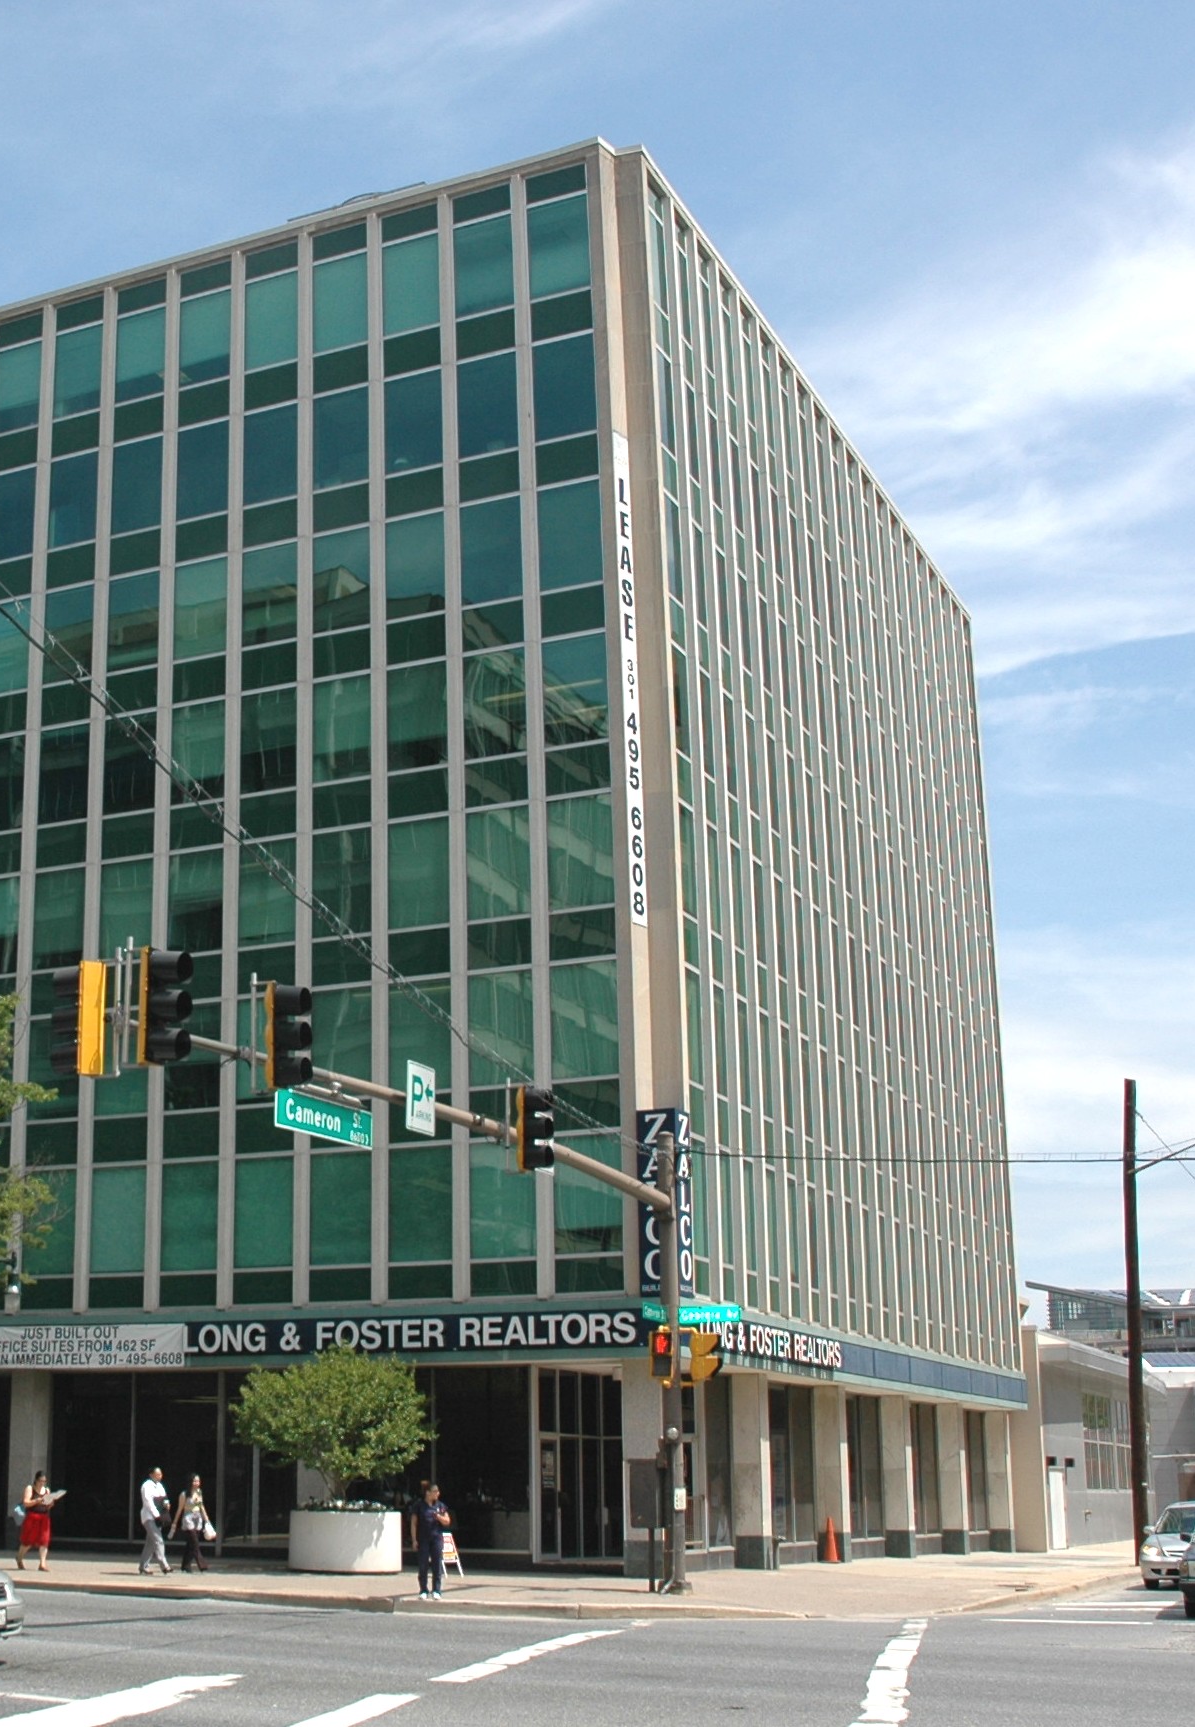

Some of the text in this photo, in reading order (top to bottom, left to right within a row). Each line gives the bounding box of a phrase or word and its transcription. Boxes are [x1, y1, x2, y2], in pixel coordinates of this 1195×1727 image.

[618, 478, 645, 916] LEASE 301 495 6608
[285, 1097, 341, 1133] Cameron
[411, 1074, 424, 1118] P
[677, 1113, 693, 1282] ZALCO
[20, 1325, 120, 1340] JUST BUILT OUT
[183, 1310, 637, 1354] LONG & FOSTER REALTORS
[680, 1309, 721, 1323] Georgia
[12, 1353, 93, 1366] IMMEDIATELY
[98, 1352, 183, 1366] 301-495-6608
[30, 1340, 75, 1353] SUITES
[77, 1340, 113, 1352] FROM
[115, 1339, 137, 1352] 462
[140, 1338, 157, 1351] SF
[737, 1322, 747, 1354] &
[750, 1324, 791, 1359] FOSTER
[794, 1333, 842, 1369] REALTORS
